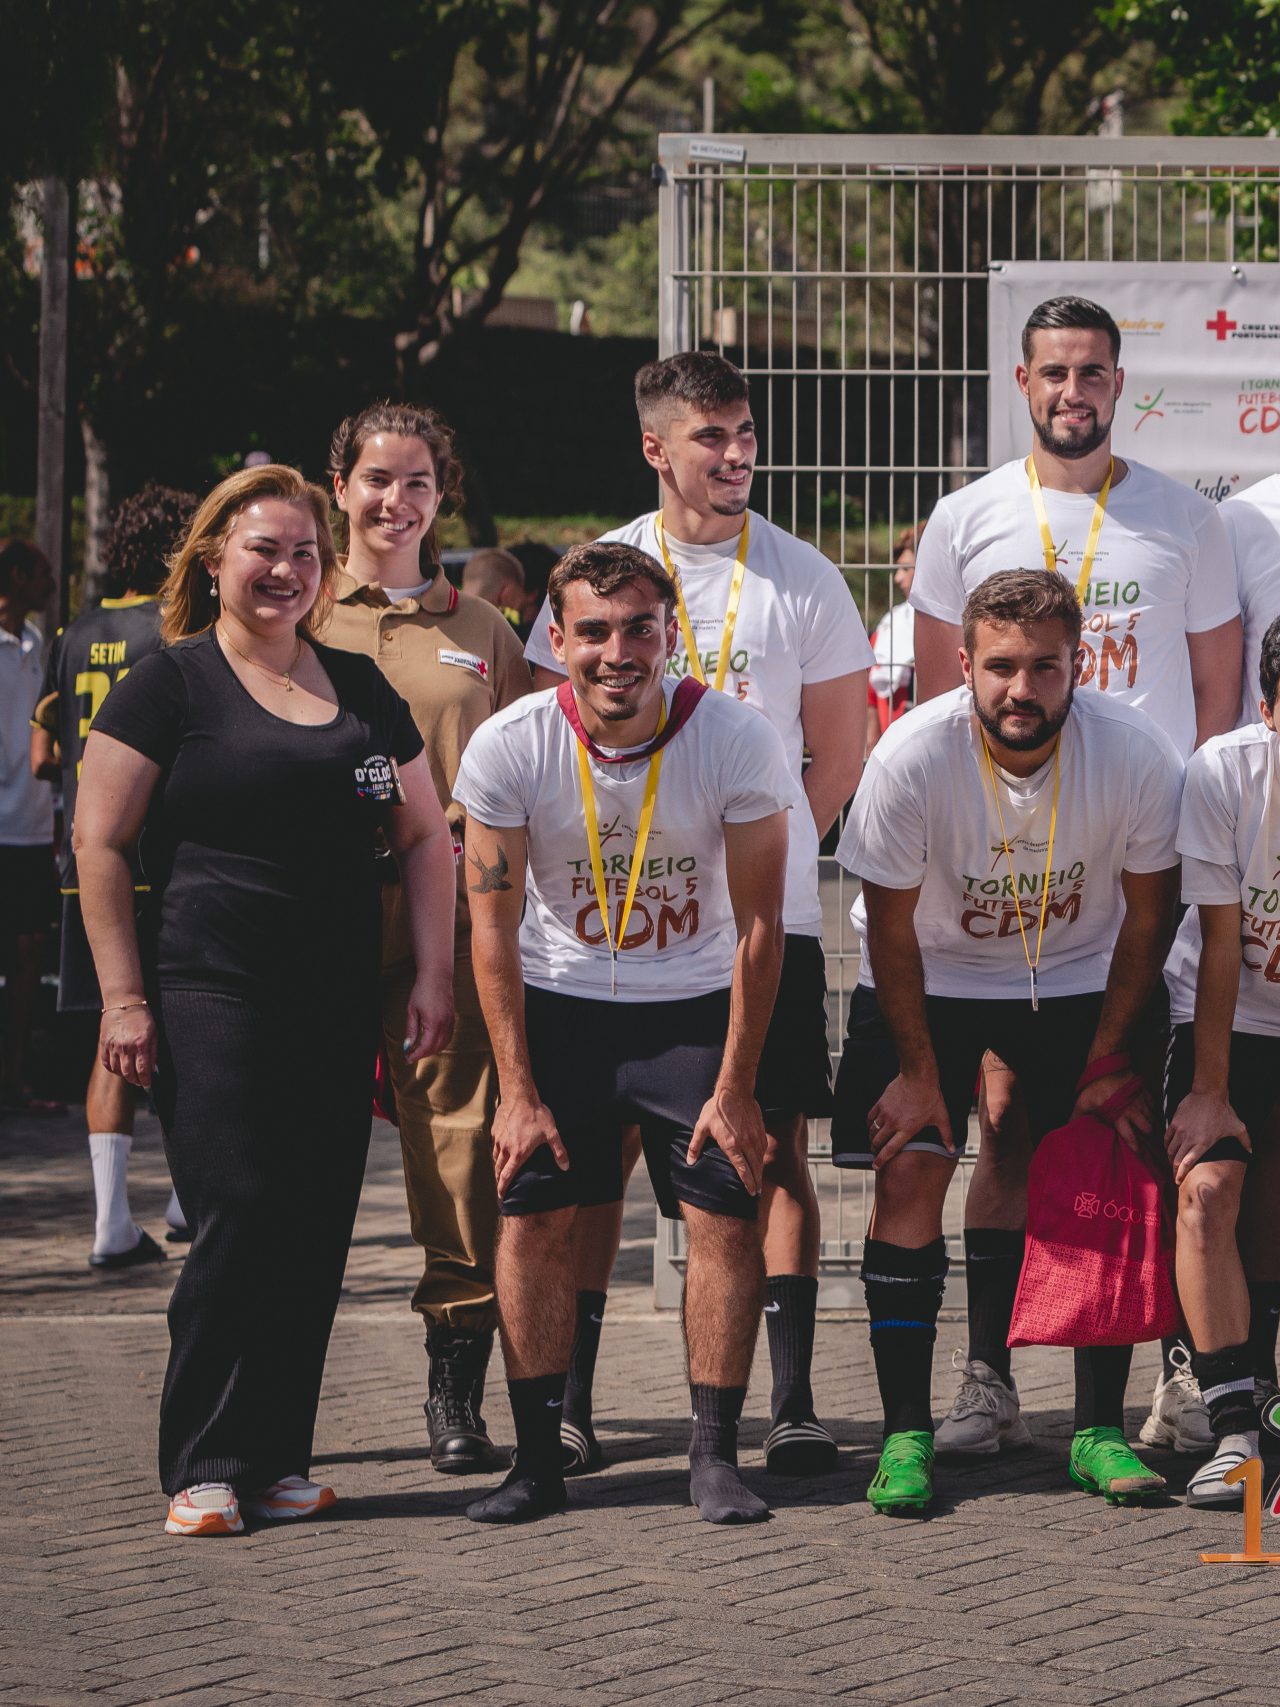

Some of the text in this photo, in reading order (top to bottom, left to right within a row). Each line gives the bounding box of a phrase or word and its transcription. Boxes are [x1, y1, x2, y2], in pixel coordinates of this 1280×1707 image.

[1242, 323, 1266, 331] CRUZ
[1127, 611, 1141, 631] 5
[737, 681, 750, 701] 5
[686, 877, 698, 895] 5
[962, 879, 1085, 912] FUTEBOL 5
[963, 861, 1085, 898] TORNEIO
[576, 898, 699, 951] CDM
[961, 892, 1082, 939] CDM
[1222, 1456, 1263, 1553] 1
